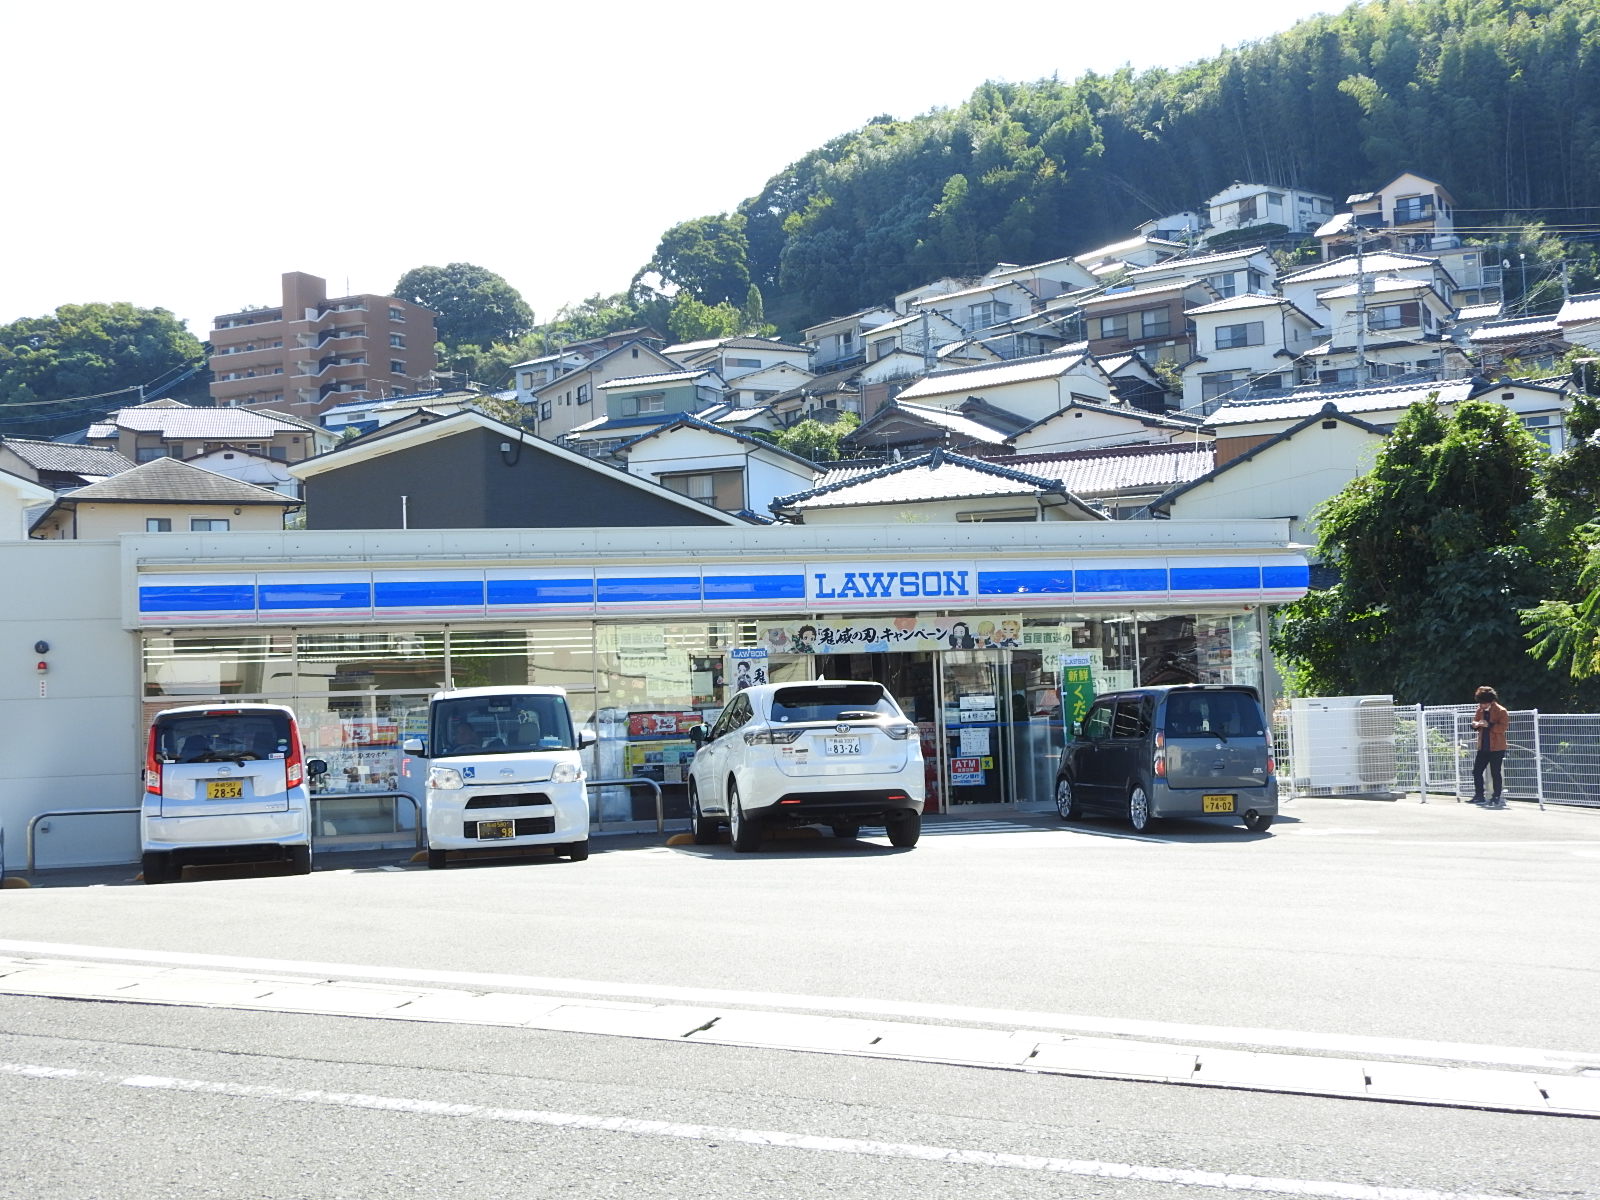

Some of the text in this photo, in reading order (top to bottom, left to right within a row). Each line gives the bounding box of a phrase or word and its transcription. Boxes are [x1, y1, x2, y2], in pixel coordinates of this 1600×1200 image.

[815, 571, 969, 598] LAWSON
[733, 650, 766, 658] LAWSON
[1064, 657, 1090, 665] LAWSON
[1068, 670, 1089, 682] 新鮮
[833, 744, 860, 754] 83-26
[955, 760, 976, 768] ATM
[214, 788, 242, 798] 28-54
[1210, 802, 1232, 811] 74-02
